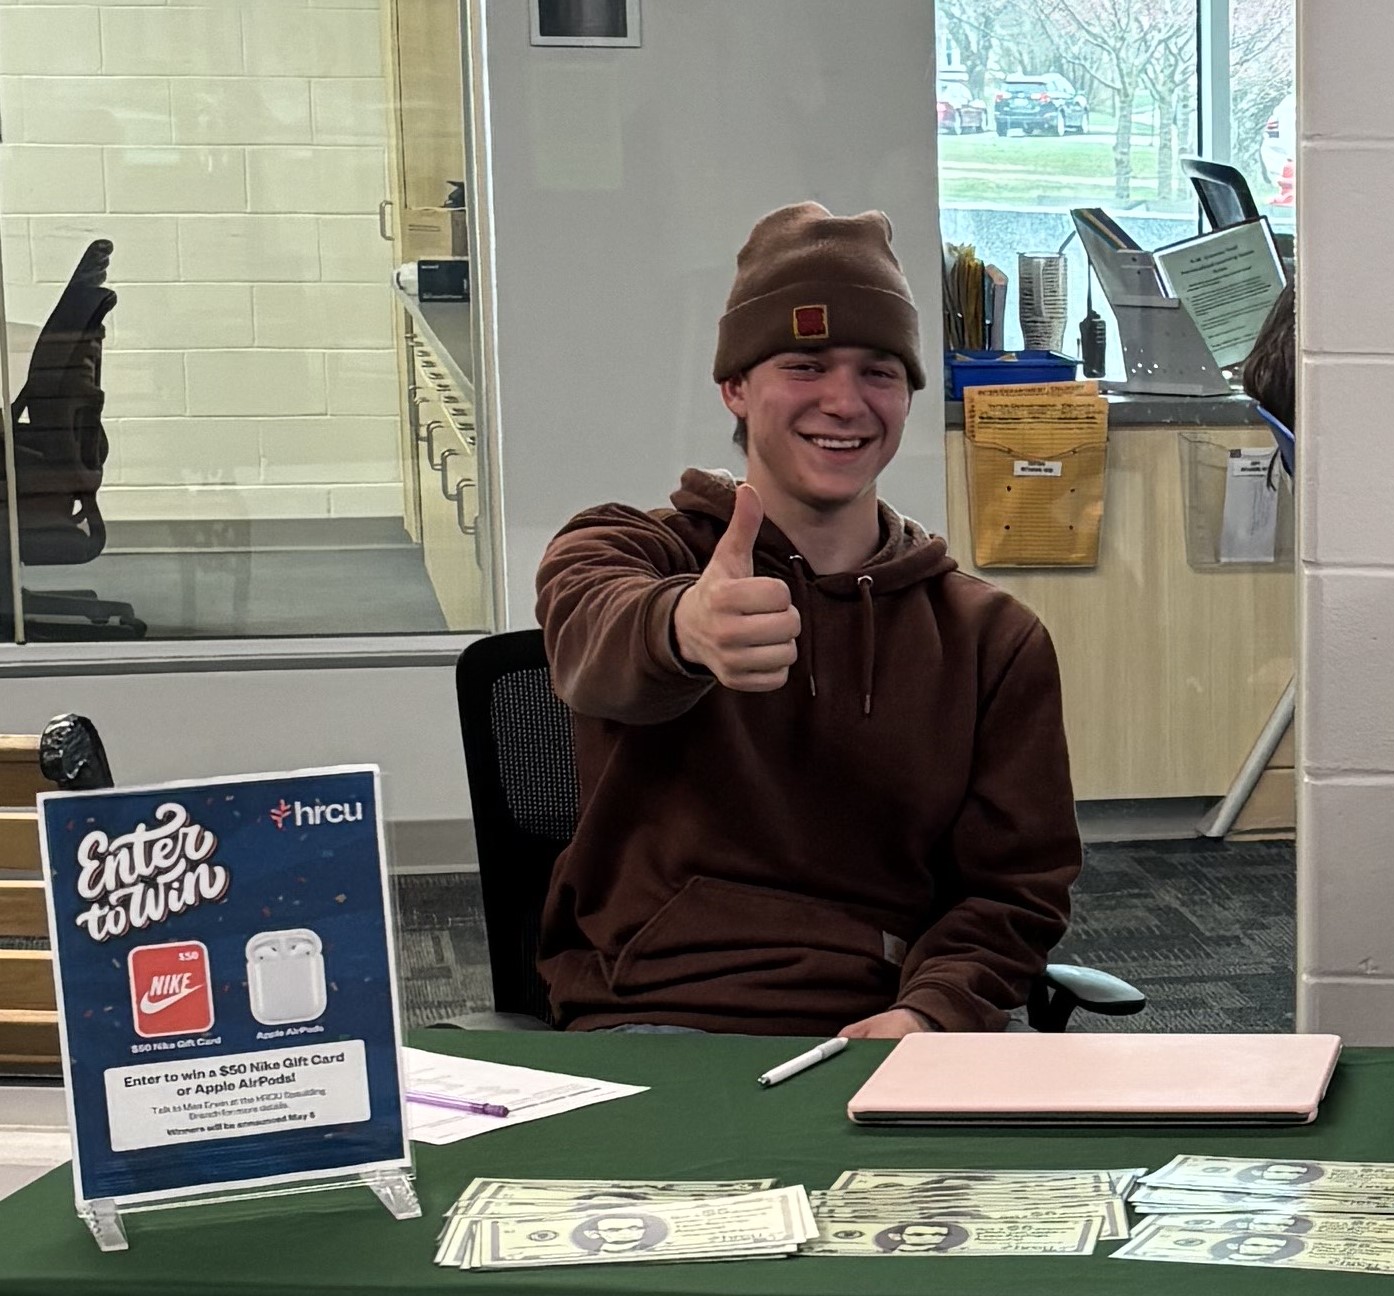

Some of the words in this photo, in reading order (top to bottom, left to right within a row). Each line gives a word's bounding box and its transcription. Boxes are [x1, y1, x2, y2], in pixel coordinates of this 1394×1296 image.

[294, 800, 363, 827] hrcu
[77, 802, 215, 900] Enter
[76, 903, 126, 941] to
[109, 858, 226, 928] Win
[150, 972, 193, 996] NIKE
[131, 1043, 152, 1054] $50
[123, 1075, 161, 1087] Enter
[164, 1073, 179, 1083] to
[181, 1069, 206, 1081] win
[208, 1068, 218, 1078] a
[219, 1063, 247, 1077] $50
[250, 1061, 281, 1073] Nike
[282, 1056, 309, 1069] Gift
[310, 1052, 345, 1065] Card
[176, 1086, 192, 1096] or
[194, 1081, 236, 1095] Apple
[238, 1072, 296, 1089] AirPods!
